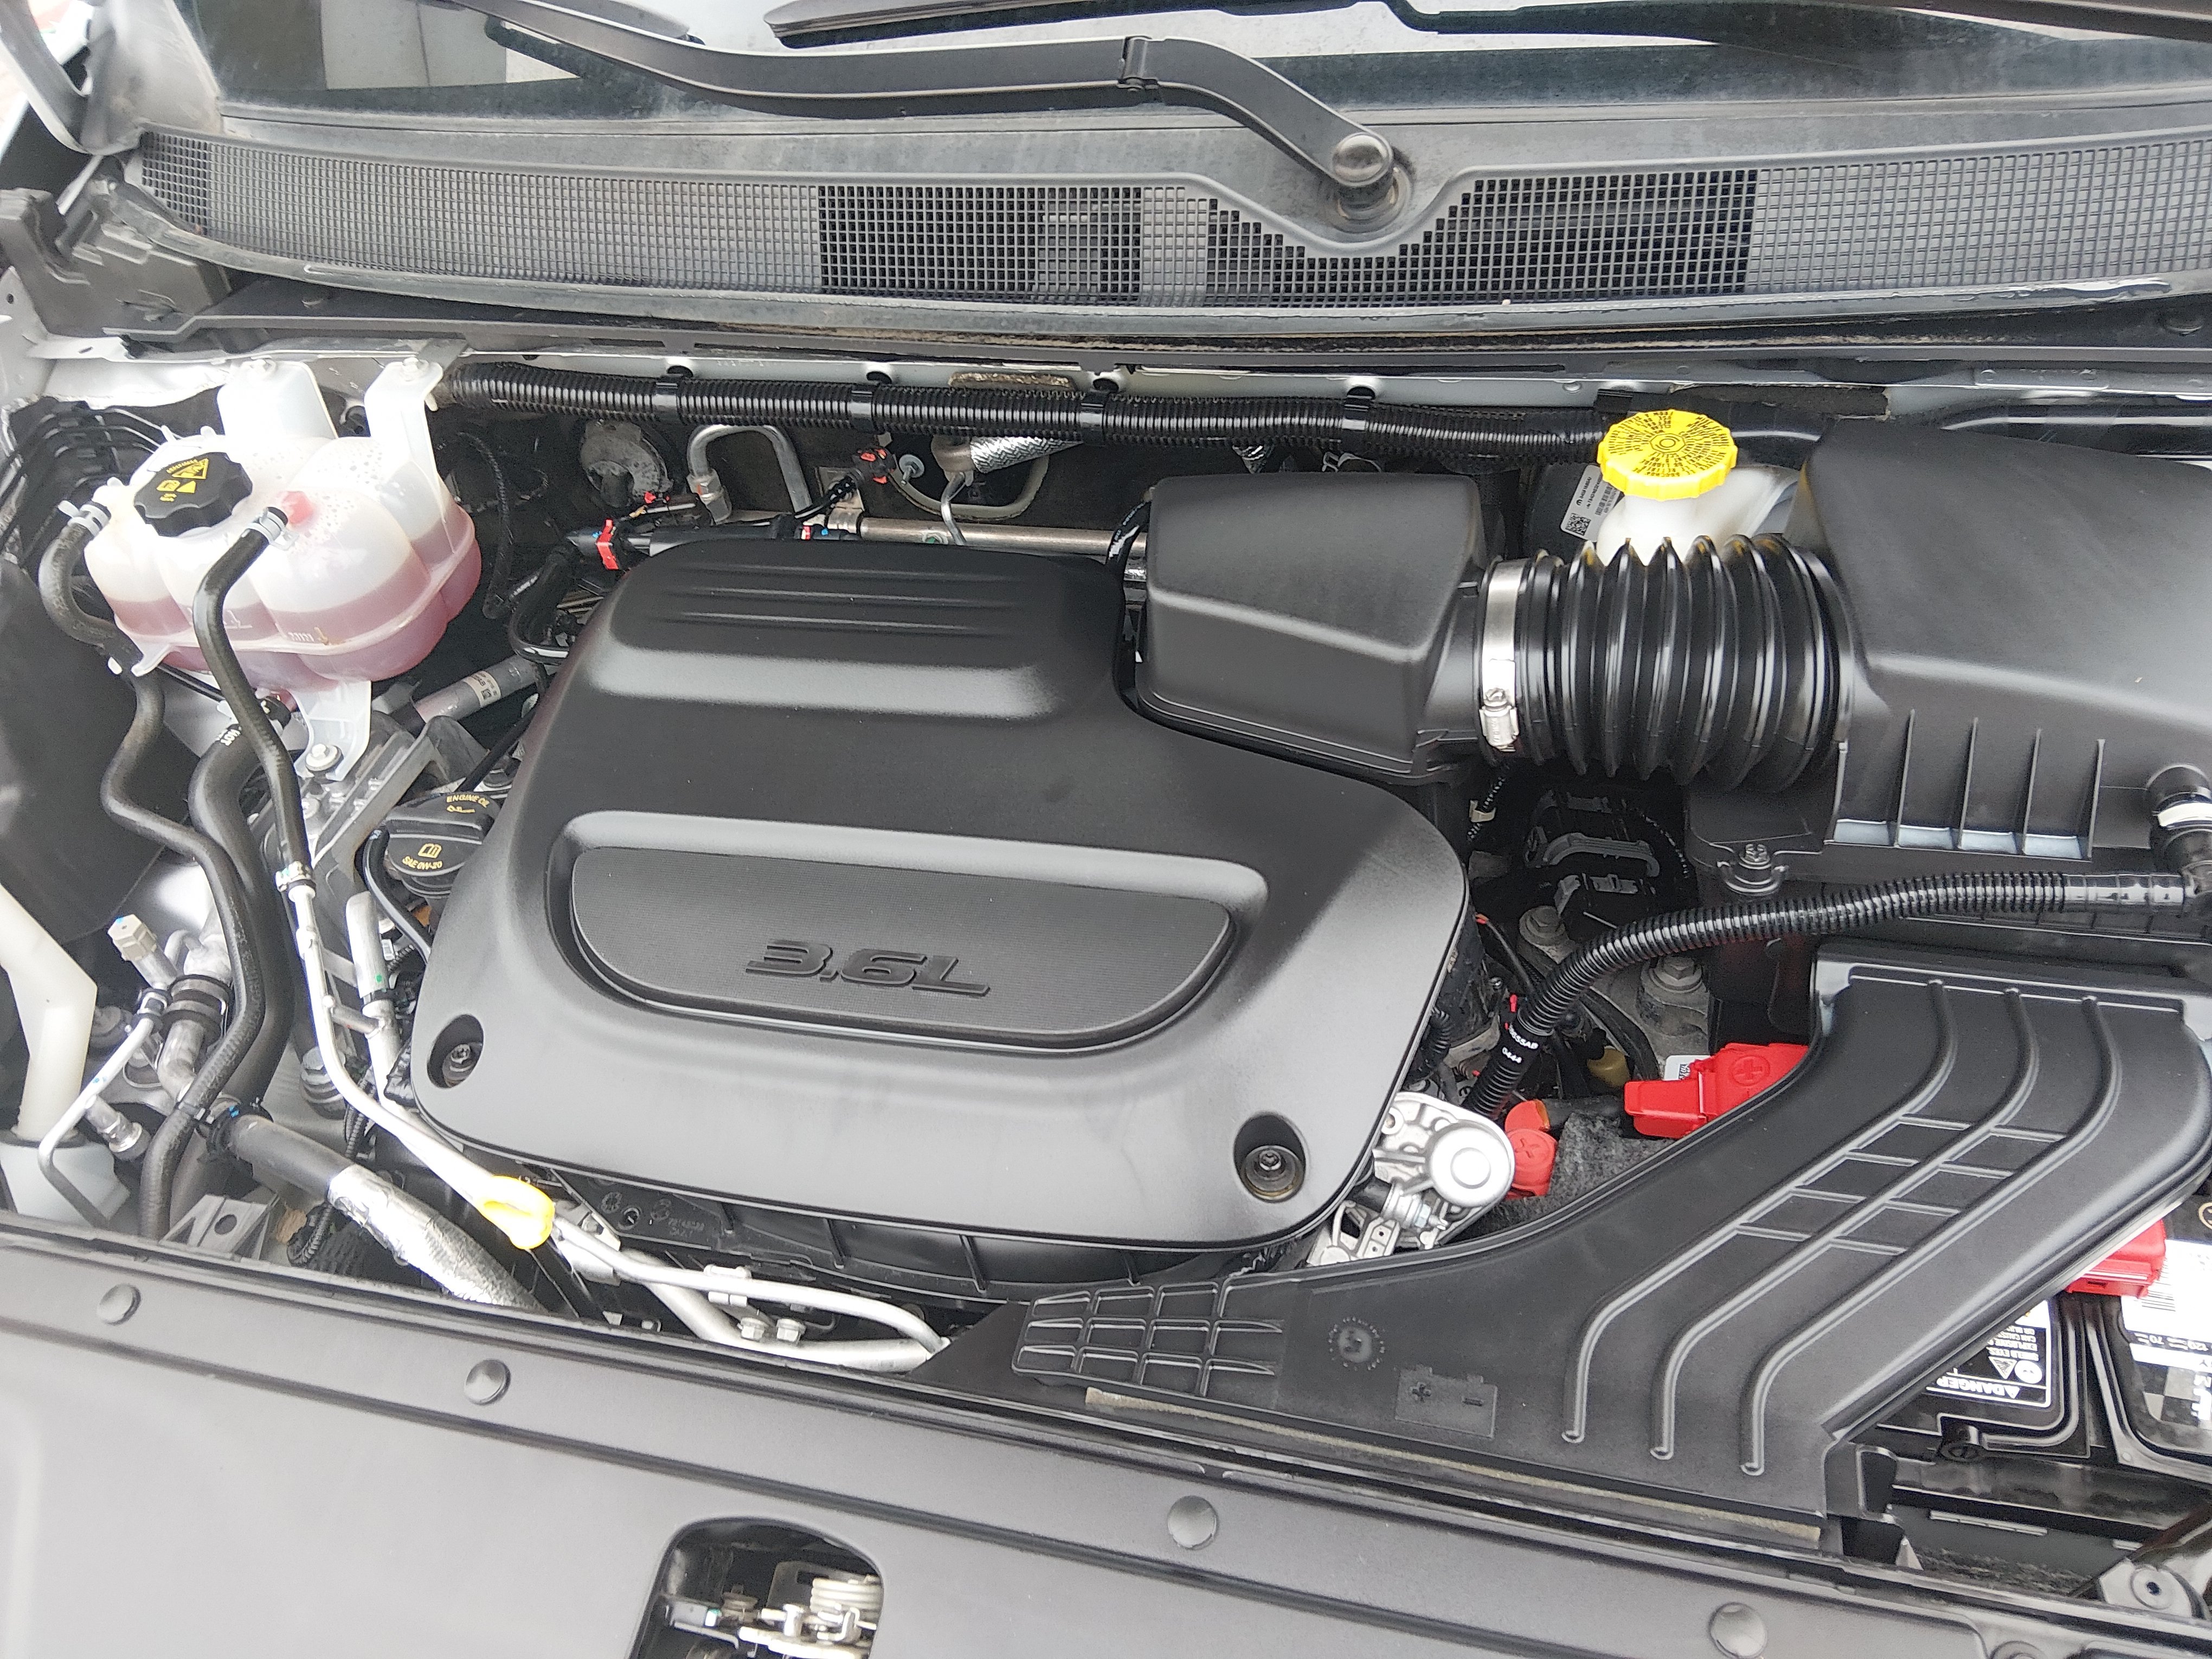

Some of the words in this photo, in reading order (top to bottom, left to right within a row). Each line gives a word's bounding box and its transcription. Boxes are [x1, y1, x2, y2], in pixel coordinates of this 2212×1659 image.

[446, 794, 480, 803] ENGINE
[402, 856, 419, 869] SAE
[745, 939, 991, 998] 3.6L
[1936, 1376, 2006, 1396] DANGER
